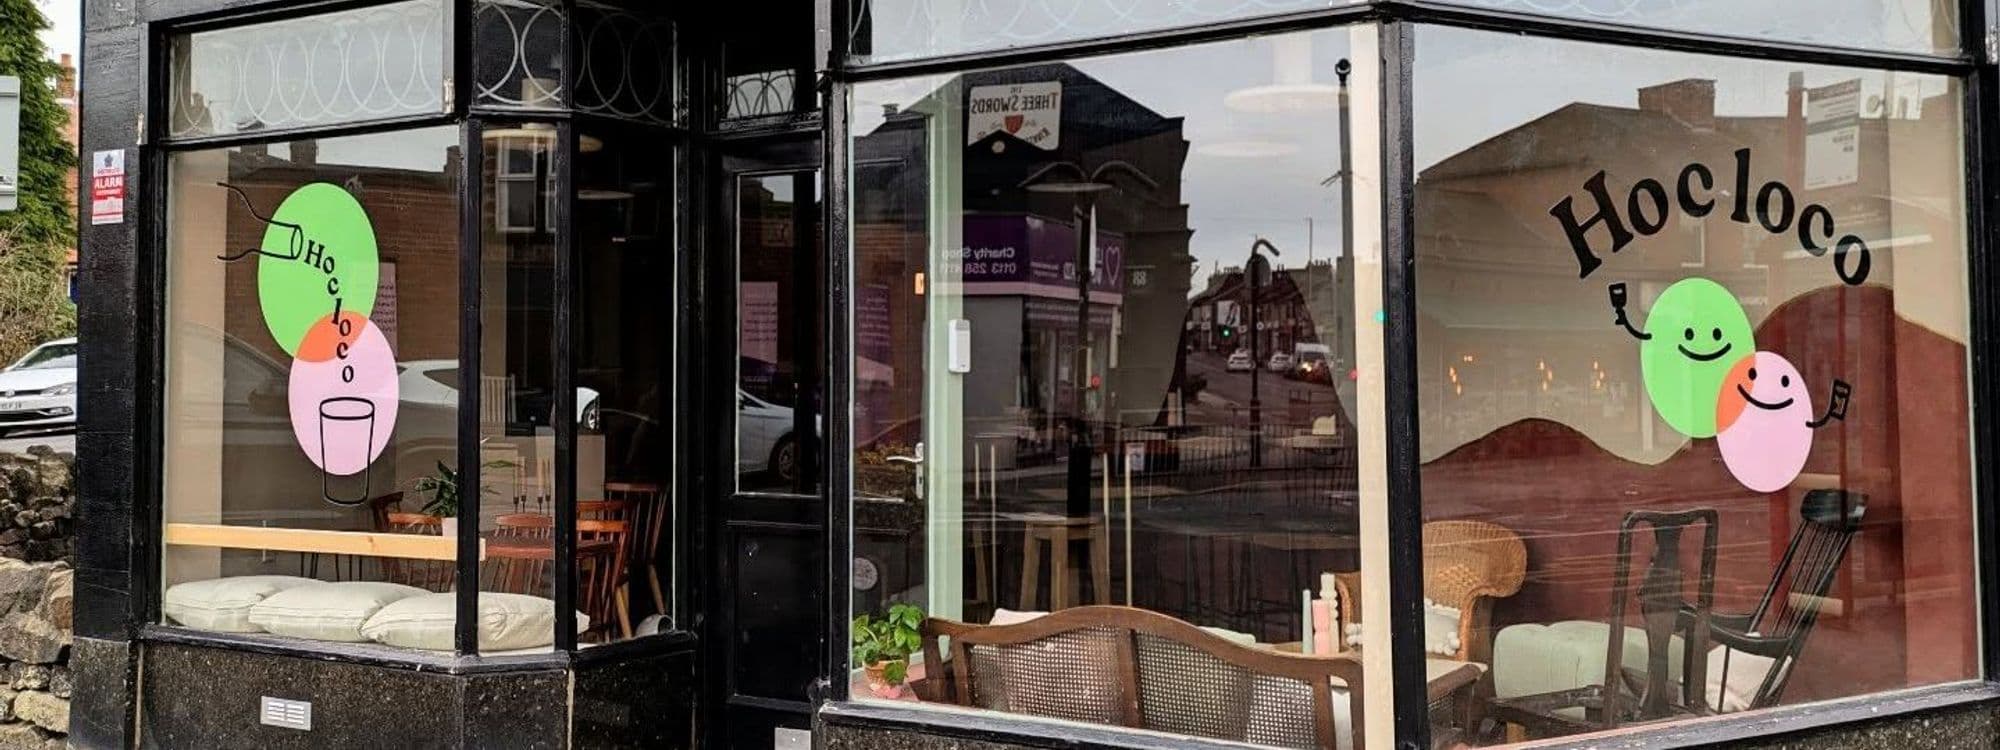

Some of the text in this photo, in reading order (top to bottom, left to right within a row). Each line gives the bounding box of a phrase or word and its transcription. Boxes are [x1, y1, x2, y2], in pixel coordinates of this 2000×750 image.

[94, 176, 123, 190] ALARM
[1549, 147, 1872, 286] Hoc loco
[304, 239, 354, 383] Hoc loco
